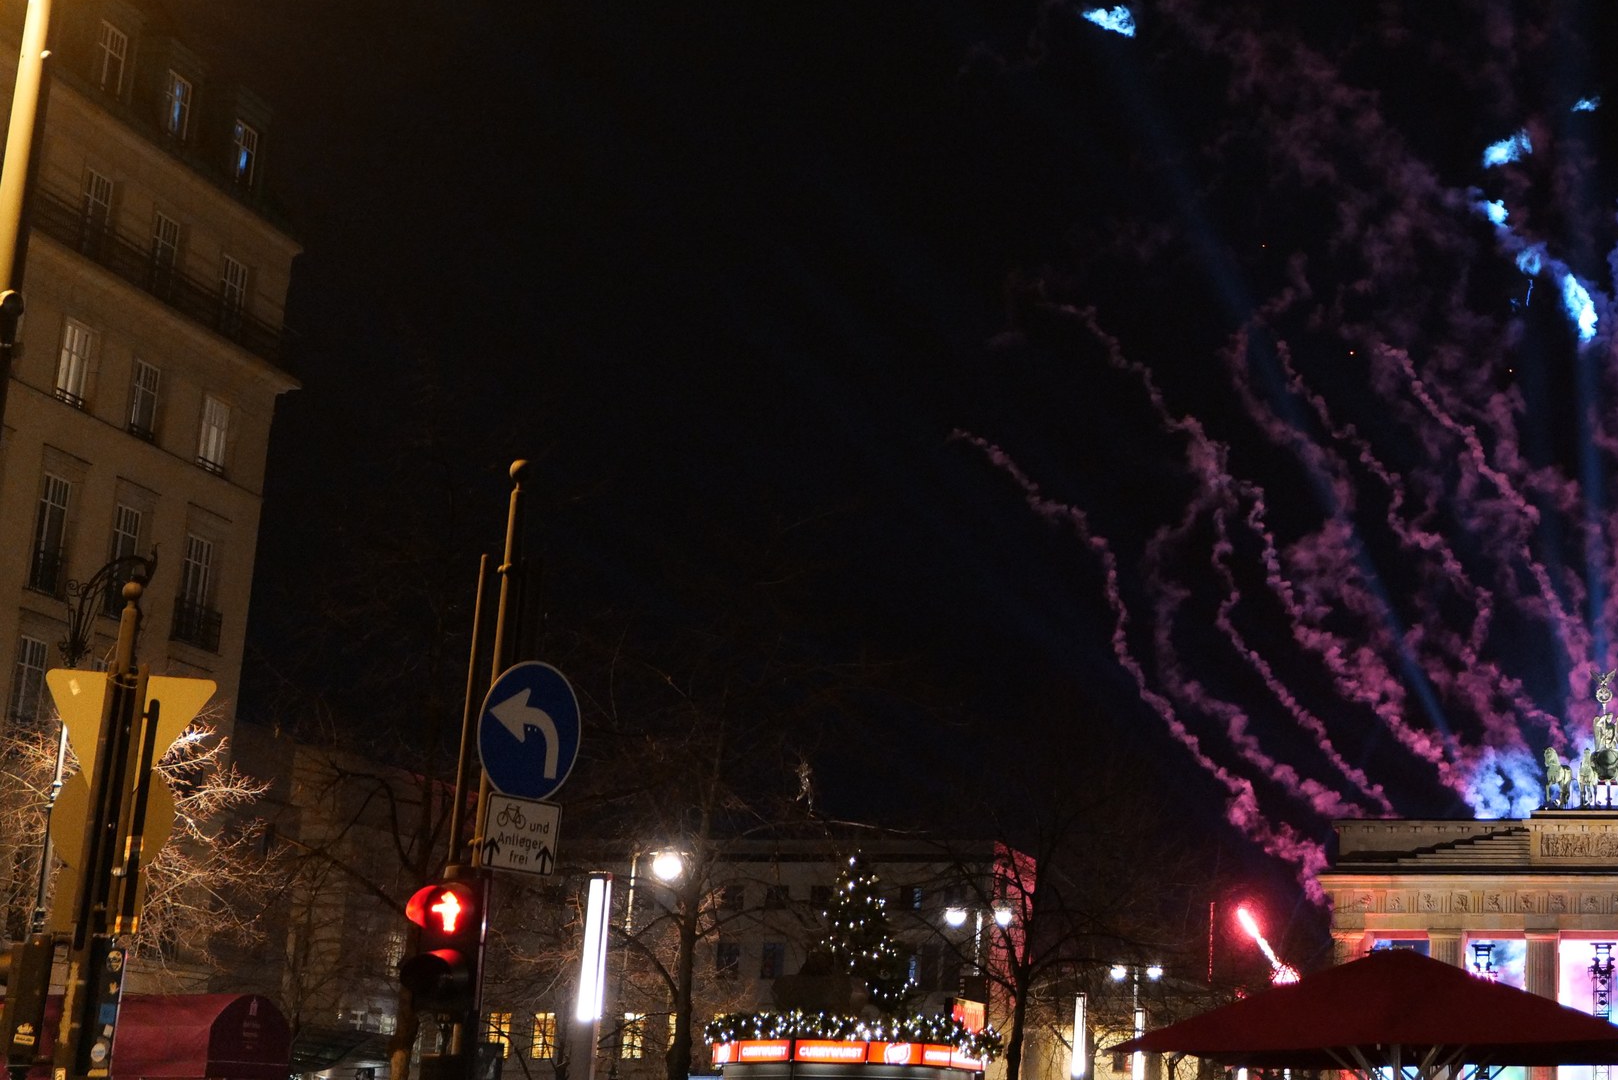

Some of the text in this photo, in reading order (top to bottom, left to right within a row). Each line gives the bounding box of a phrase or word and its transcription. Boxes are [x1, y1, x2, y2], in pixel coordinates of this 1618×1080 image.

[529, 821, 550, 834] und
[497, 831, 544, 851] Anlieger
[509, 850, 529, 864] frei
[742, 1046, 787, 1057] CURRYWURST
[799, 1046, 863, 1058] CURRYWURST
